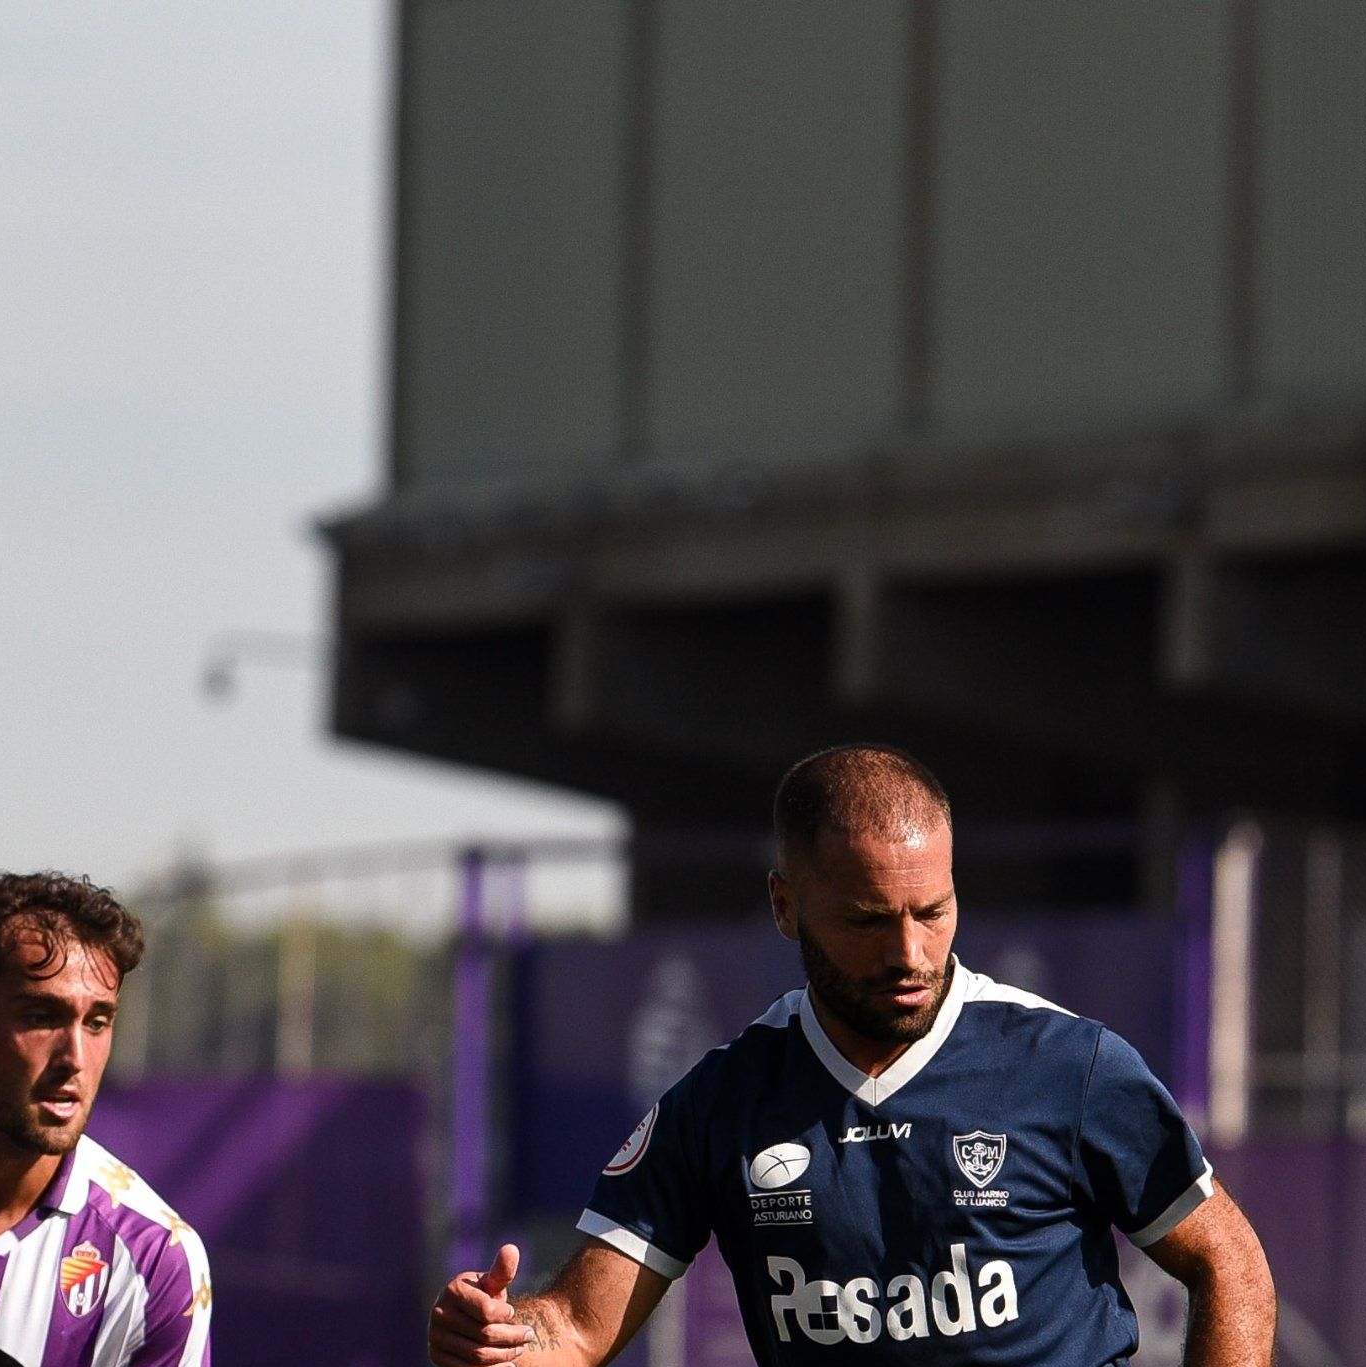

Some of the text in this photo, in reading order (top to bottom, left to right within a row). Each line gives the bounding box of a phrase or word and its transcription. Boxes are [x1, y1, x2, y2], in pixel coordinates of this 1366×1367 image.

[977, 1190, 1010, 1199] MARINO
[750, 1195, 812, 1210] DEPORTE
[955, 1198, 1007, 1207] DE LUANCO
[753, 1209, 813, 1223] ASTURIANO
[766, 1243, 1019, 1345] Posada
